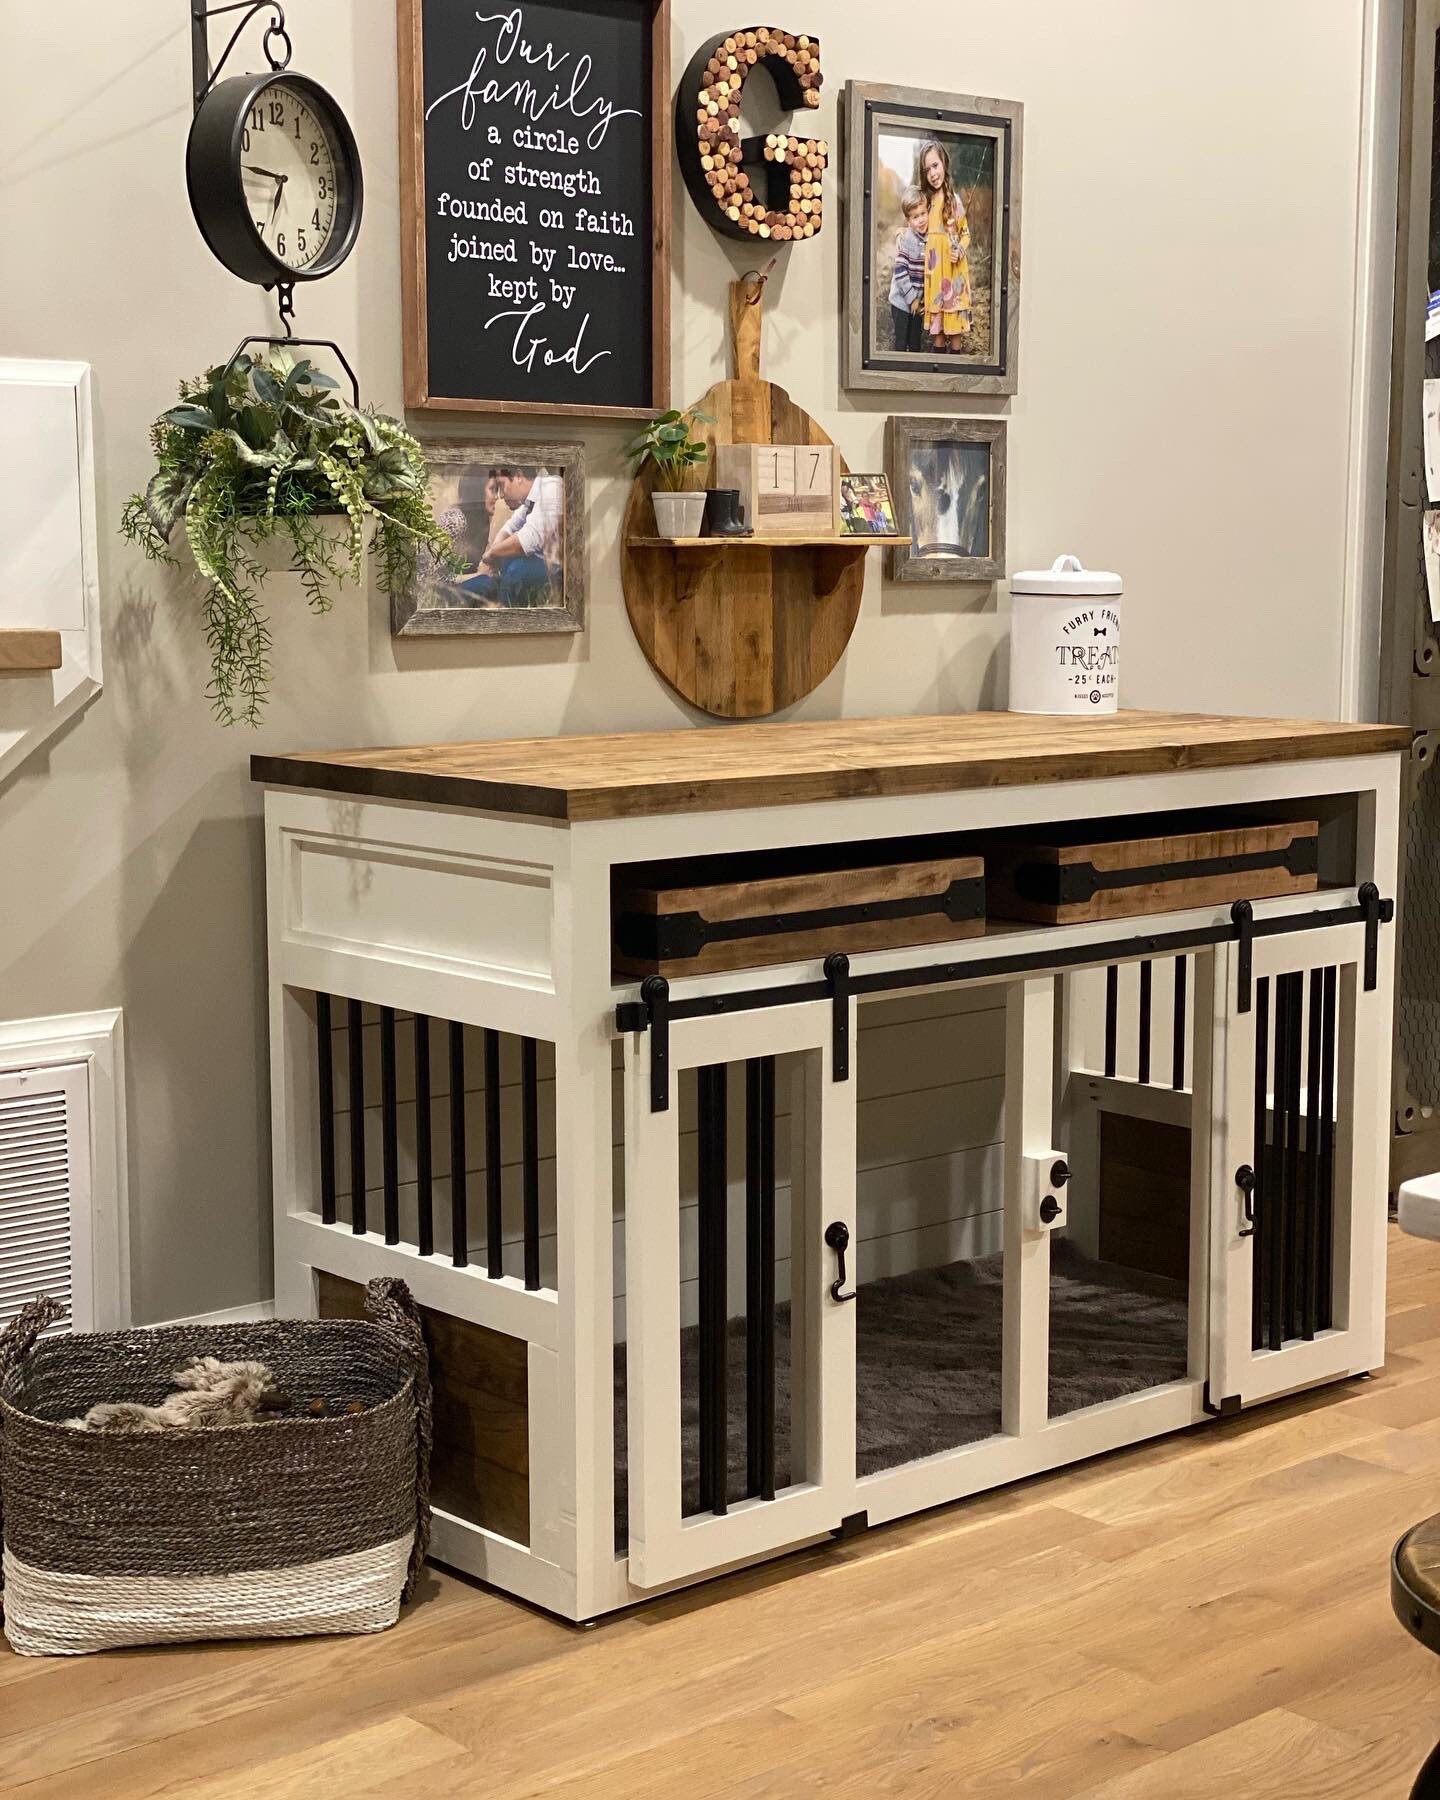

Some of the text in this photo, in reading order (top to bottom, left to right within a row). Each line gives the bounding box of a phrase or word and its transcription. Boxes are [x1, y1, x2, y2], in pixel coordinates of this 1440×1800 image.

[476, 9, 569, 71] Our
[426, 48, 643, 150] family
[251, 107, 265, 131] 11
[269, 103, 284, 126] 12
[294, 117, 302, 139] 1
[487, 125, 579, 154] a circle
[676, 26, 829, 242] G
[310, 142, 320, 165] 2
[318, 176, 327, 200] 3
[468, 158, 601, 197] of strength
[311, 208, 321, 231] 4
[438, 193, 634, 236] founded on faith
[277, 233, 286, 256] 6
[297, 229, 306, 251] 5
[448, 233, 518, 262] joined
[529, 241, 557, 272] by
[488, 273, 576, 309] kept by
[484, 302, 611, 373] God
[1062, 610, 1094, 635] FURRY
[1055, 645, 1120, 670] TREAT
